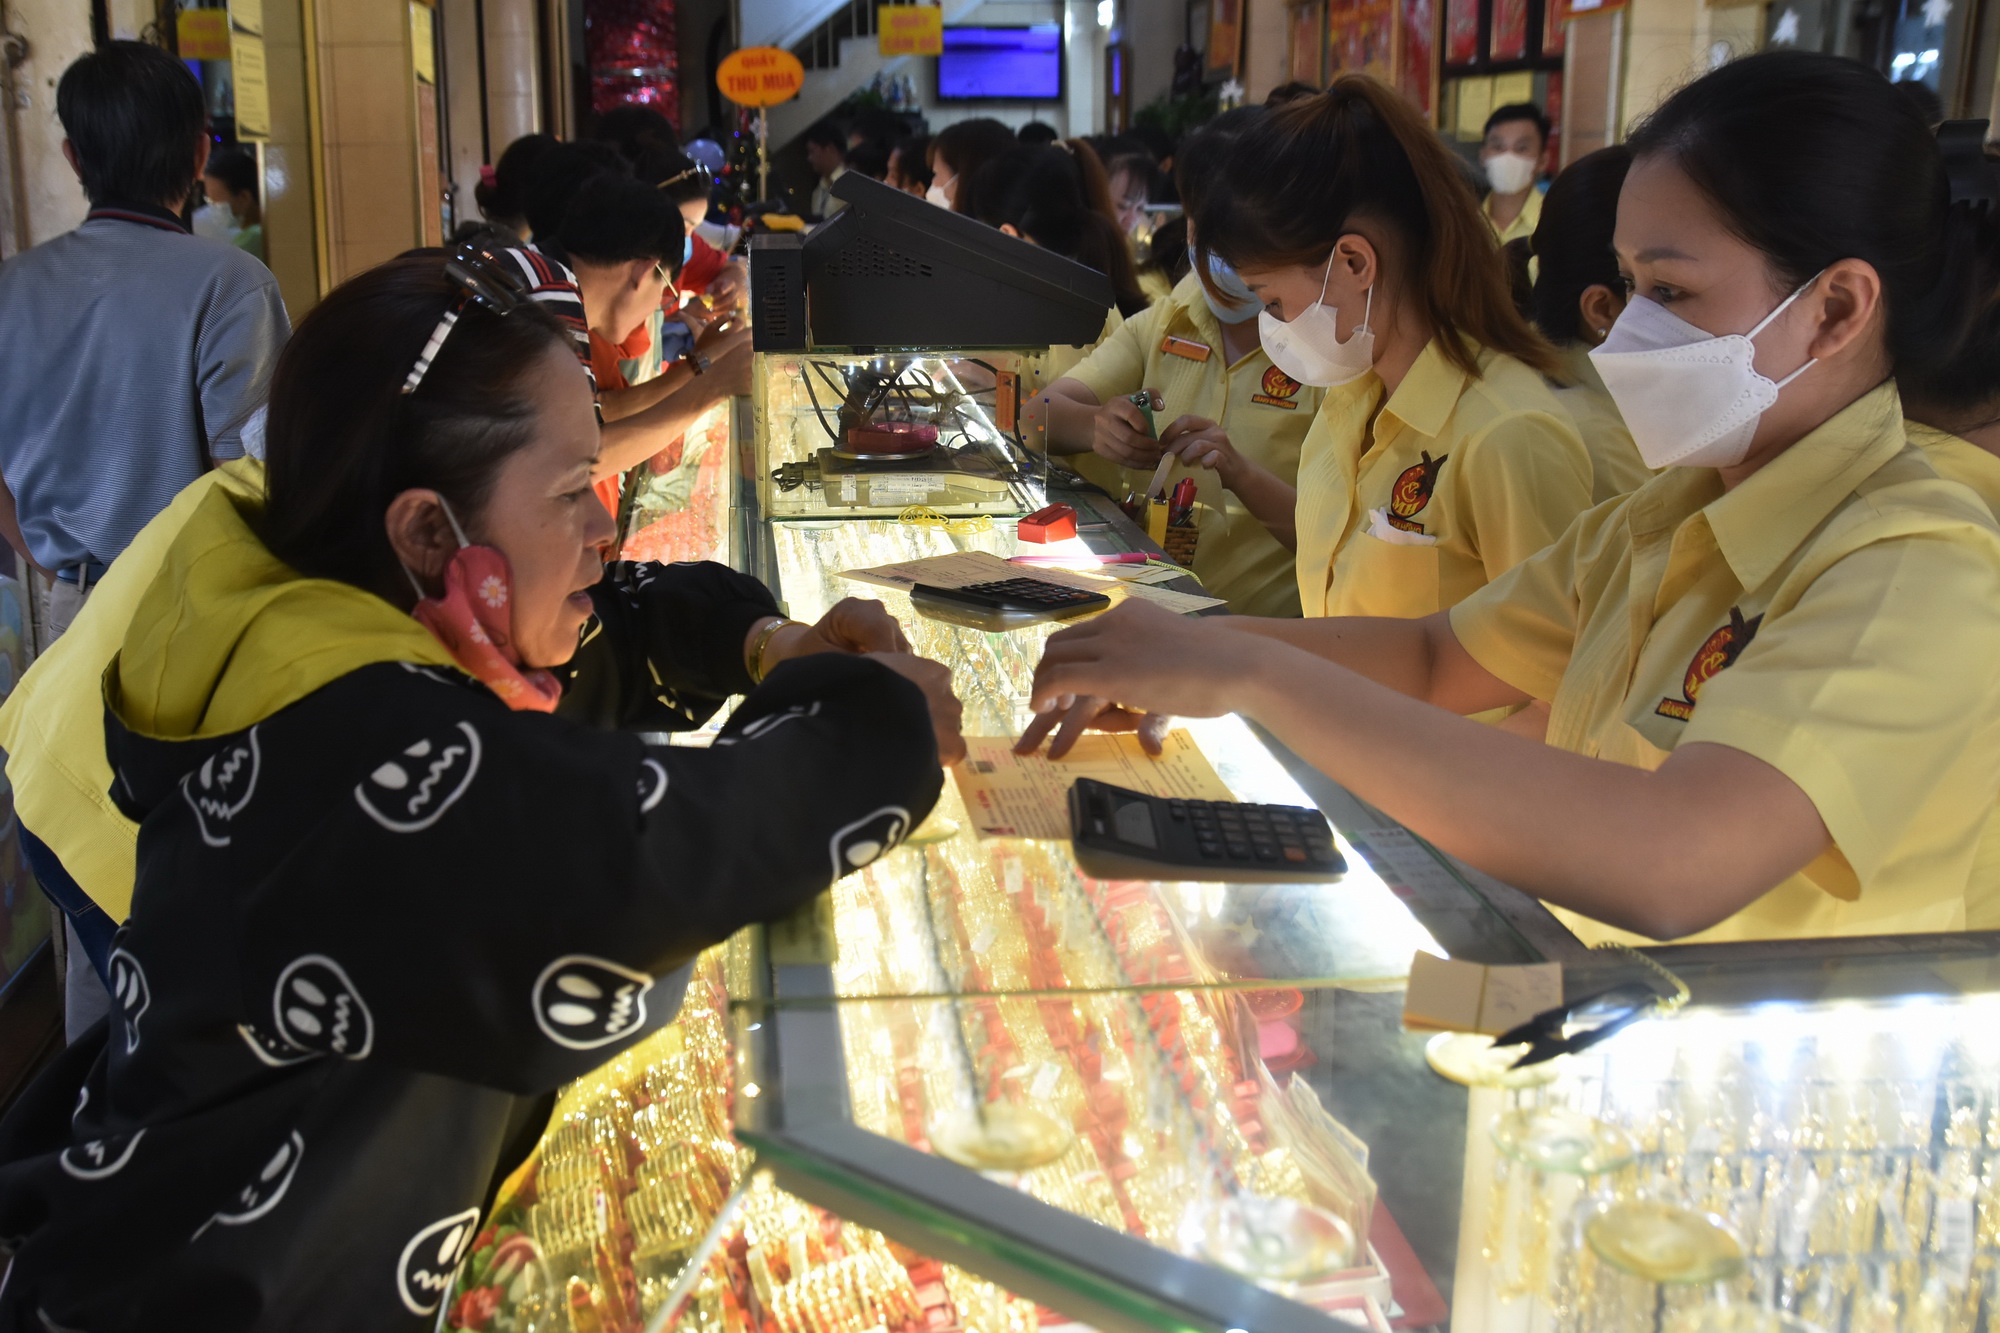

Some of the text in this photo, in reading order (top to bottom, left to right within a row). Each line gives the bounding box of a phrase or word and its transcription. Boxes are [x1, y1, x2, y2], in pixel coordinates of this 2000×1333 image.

[728, 72, 796, 92] THU MUA
[1392, 495, 1420, 515] MH
